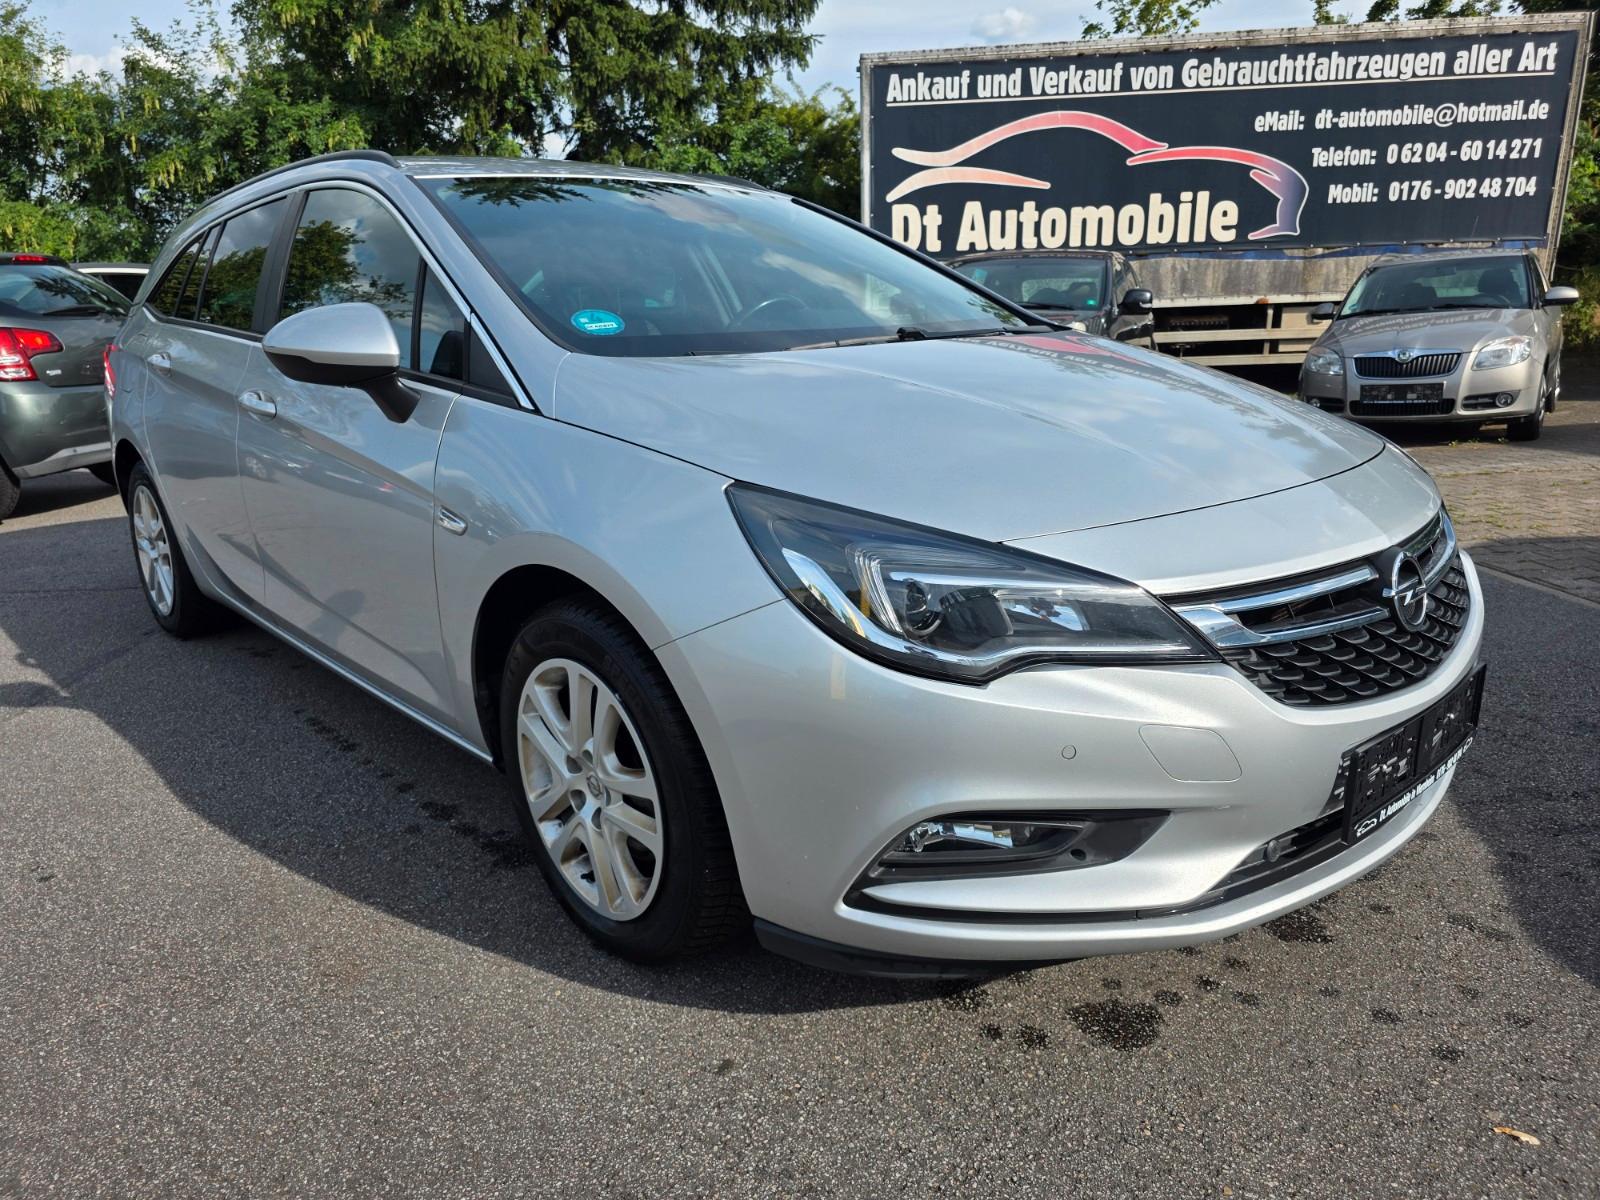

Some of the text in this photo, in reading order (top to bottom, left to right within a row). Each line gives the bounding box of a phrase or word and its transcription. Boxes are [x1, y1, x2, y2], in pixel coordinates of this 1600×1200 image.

[886, 42, 1558, 102] Ankauf und Verkauf von Gebrauchtfahrzeugen aller Art
[1254, 99, 1549, 133] eMail: dt-automobile@hotmail.de
[1311, 146, 1376, 168] Telefon:
[1327, 182, 1379, 204] Mobil:
[891, 190, 1240, 253] Dt Automobile
